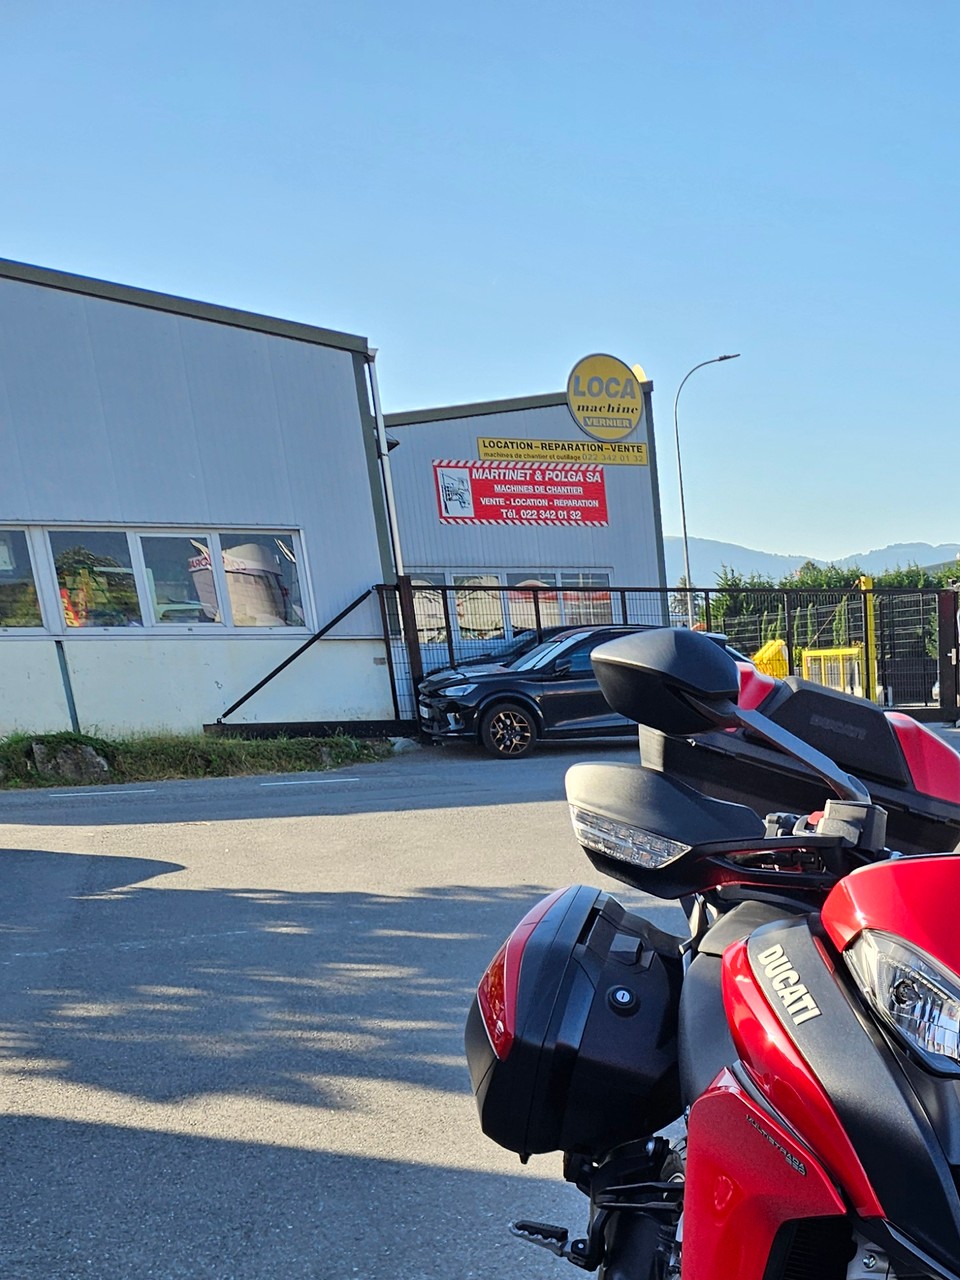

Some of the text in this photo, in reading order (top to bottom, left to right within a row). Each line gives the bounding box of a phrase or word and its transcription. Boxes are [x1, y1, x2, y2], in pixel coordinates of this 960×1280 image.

[573, 375, 636, 399] LOCA
[577, 403, 639, 414] machine
[585, 418, 630, 427] VERNIER
[483, 451, 513, 459] machines
[582, 453, 598, 461] 022
[601, 453, 617, 461] 342
[620, 454, 631, 462] 01
[635, 455, 644, 463] 32
[472, 468, 602, 483] MARTINET & POLGA SA
[494, 484, 583, 495] MACHINES DE CHANTIER
[480, 497, 505, 505] VENTE
[511, 498, 548, 506] LOCATION
[553, 499, 599, 507] REPARATION
[501, 509, 582, 520] Tél. 022 342 01 32
[757, 943, 822, 1026] DUCATI
[745, 1114, 806, 1171] MULTISTRADA
